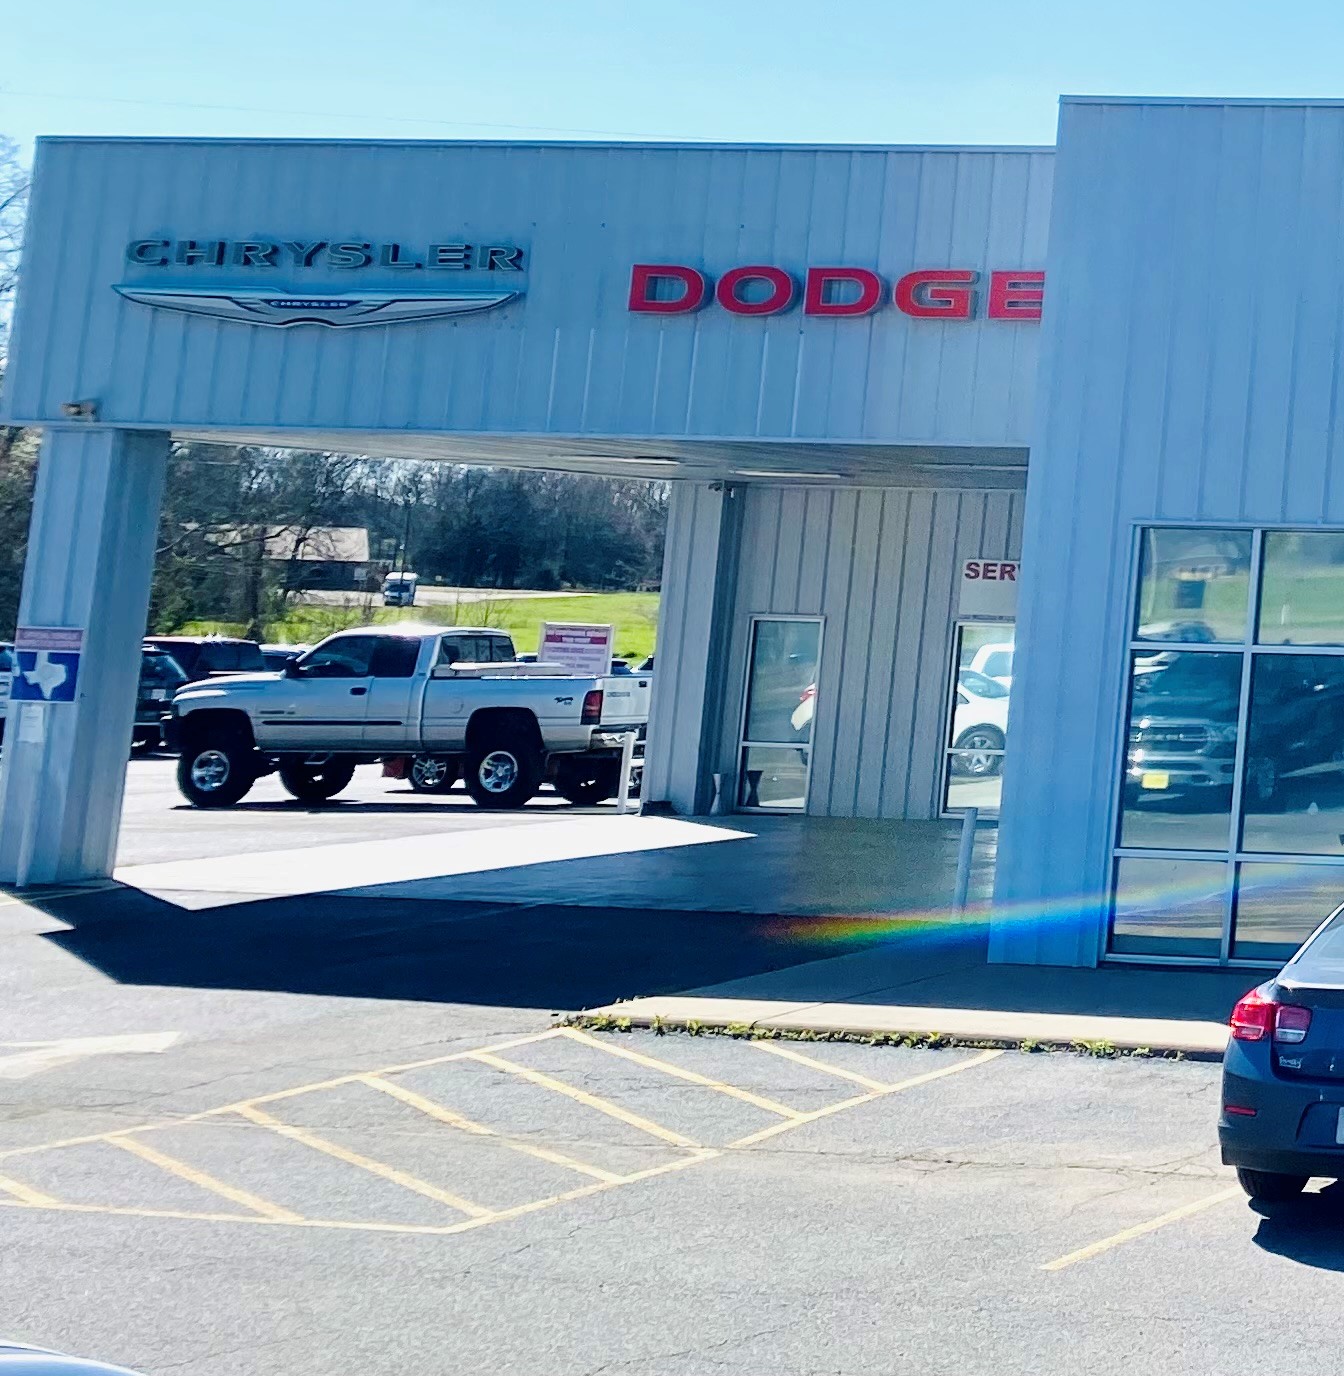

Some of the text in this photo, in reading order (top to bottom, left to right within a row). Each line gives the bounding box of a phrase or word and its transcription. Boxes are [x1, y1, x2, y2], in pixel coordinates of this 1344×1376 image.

[126, 239, 526, 272] CHRYSLER
[628, 263, 1047, 320] DODGE
[964, 561, 1020, 581] SER
